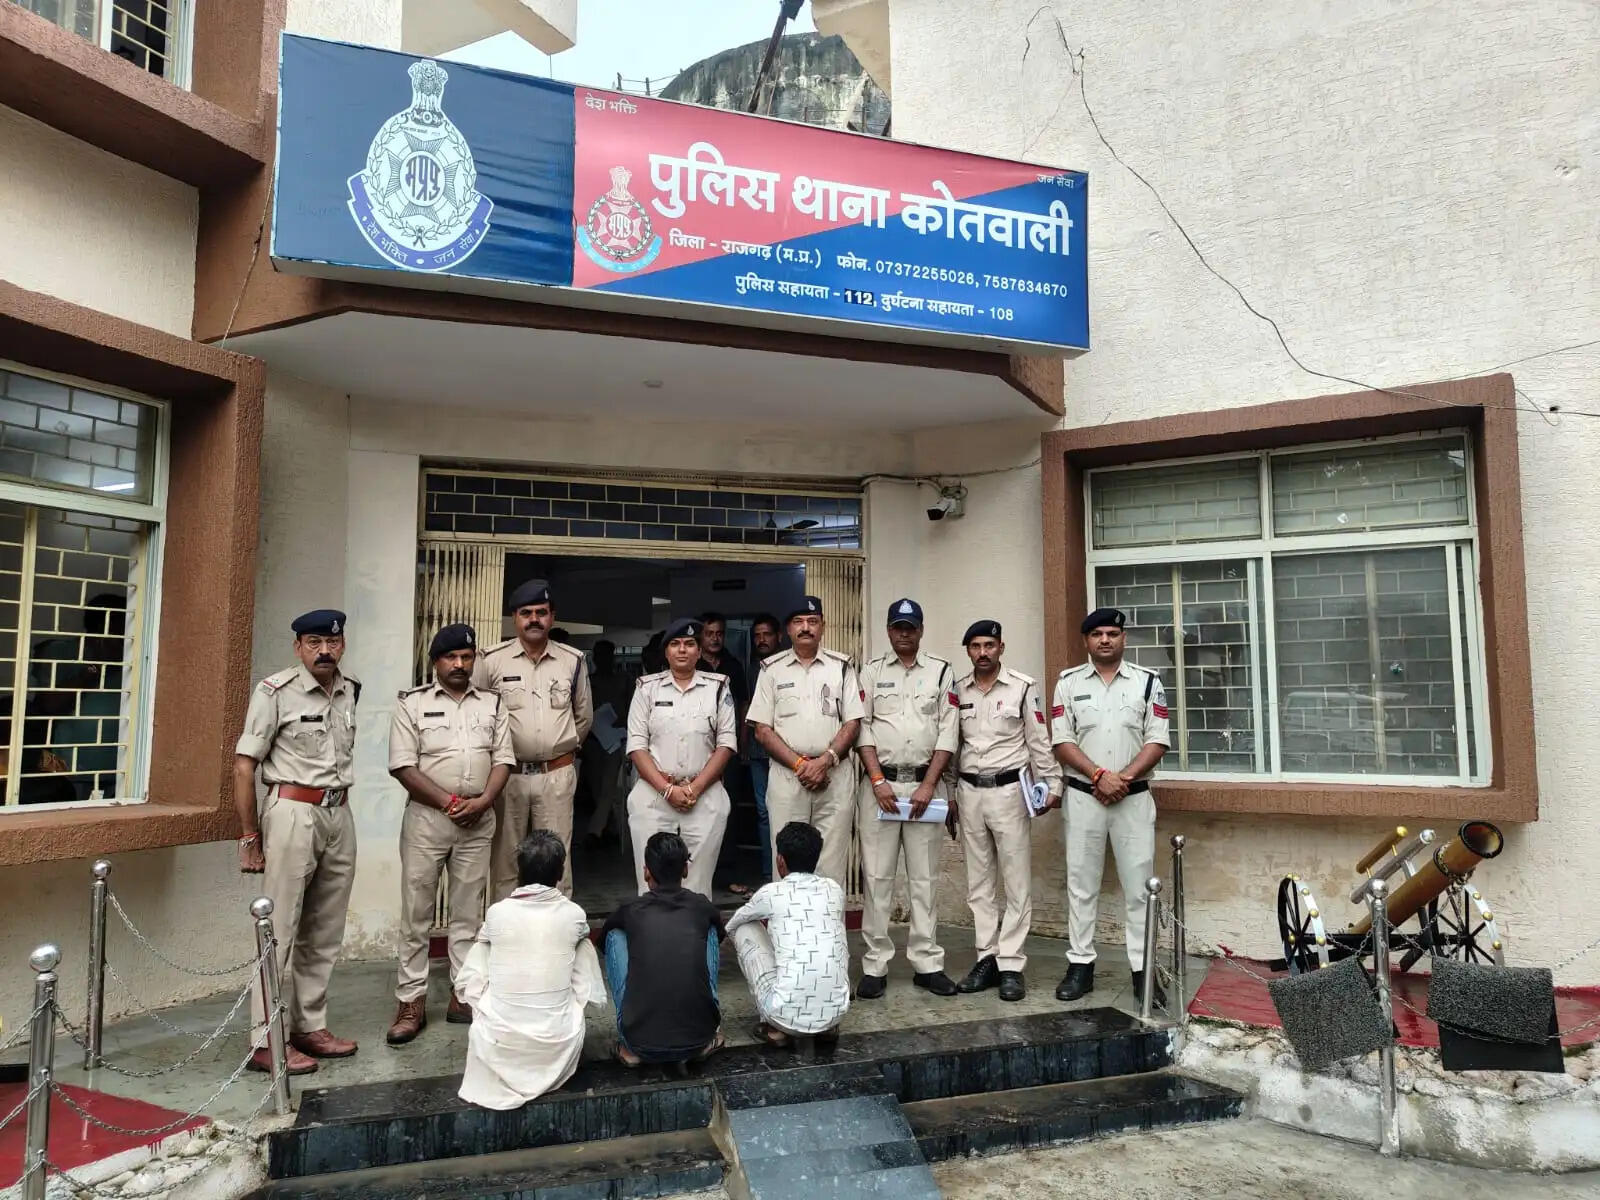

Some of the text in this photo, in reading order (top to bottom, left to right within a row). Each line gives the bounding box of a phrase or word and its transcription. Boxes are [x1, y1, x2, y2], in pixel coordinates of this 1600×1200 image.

[584, 92, 607, 111] देश
[1035, 173, 1055, 185] जन
[648, 141, 1074, 256] पुलिस थाना कोतवाली
[668, 228, 706, 250] जिला
[721, 239, 773, 261] राजगढ़
[775, 244, 822, 268] (म.प्र.)
[735, 272, 775, 295] पुलिस
[778, 281, 830, 300] सहायता
[880, 290, 925, 312] दुर्घटना
[926, 298, 975, 316] सहायता
[989, 307, 1014, 321] 108
[983, 274, 1068, 298] 7587634670
